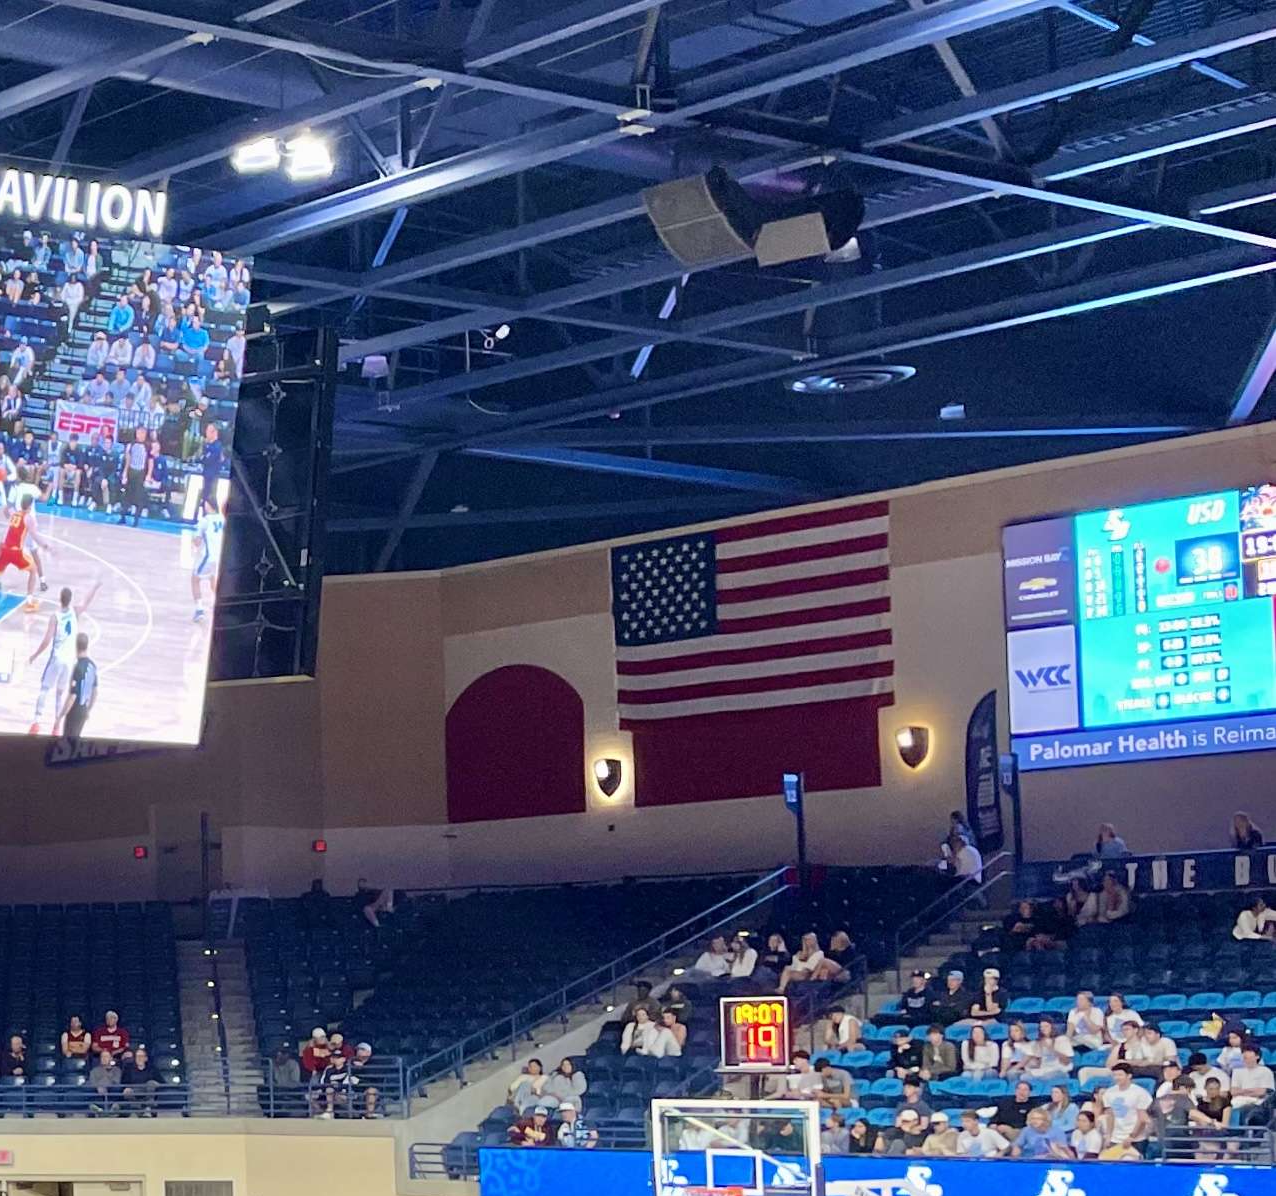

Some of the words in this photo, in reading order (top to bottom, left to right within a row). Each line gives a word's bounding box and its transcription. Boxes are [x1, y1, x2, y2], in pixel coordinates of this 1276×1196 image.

[57, 411, 118, 434] ESPN
[1014, 664, 1071, 688] WCC
[1029, 740, 1112, 761] Palomar
[1118, 729, 1187, 753] Health
[1192, 730, 1208, 747] is
[1213, 724, 1276, 745] Reima
[1125, 858, 1196, 892] THE
[735, 1003, 783, 1025] 19:07
[749, 1026, 779, 1060] 19
